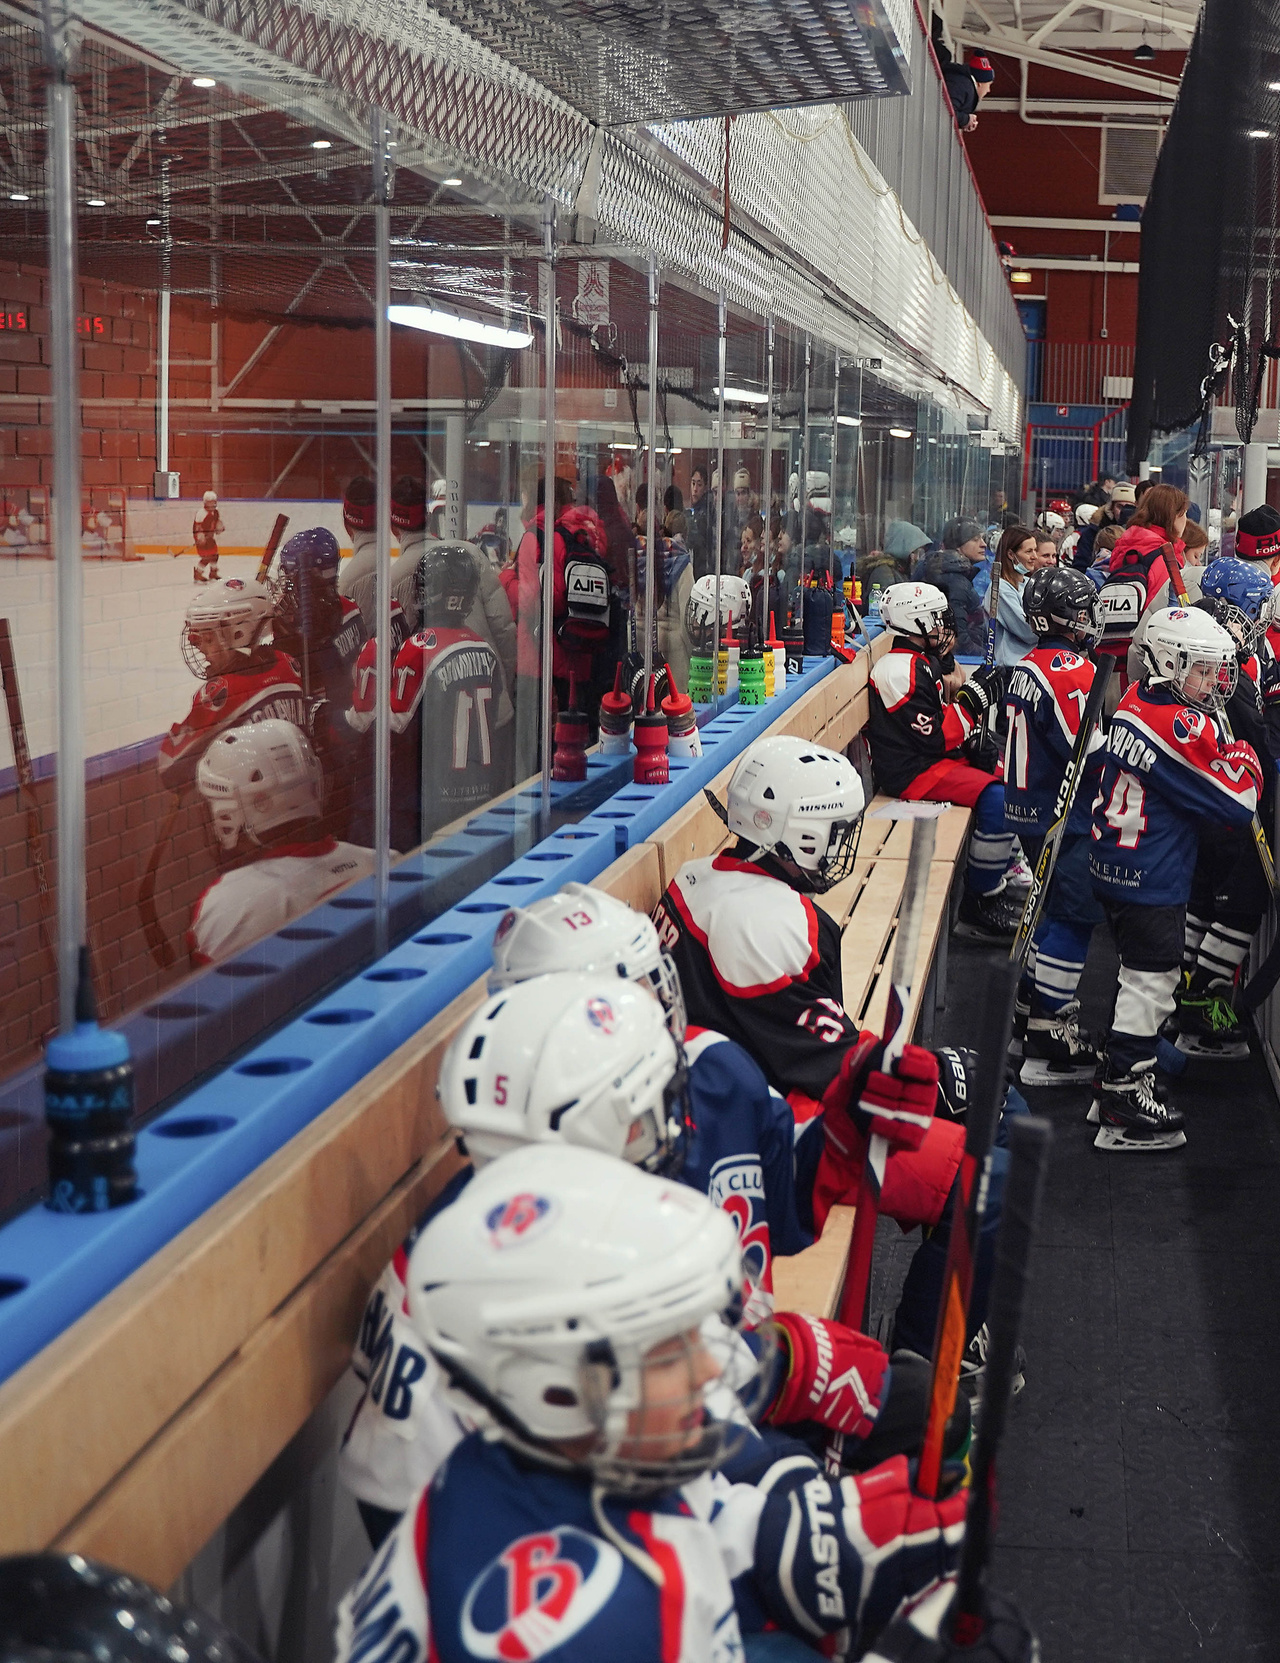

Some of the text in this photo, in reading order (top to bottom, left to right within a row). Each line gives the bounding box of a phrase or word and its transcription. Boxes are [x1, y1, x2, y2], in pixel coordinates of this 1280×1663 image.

[1102, 598, 1132, 612] FILA
[1031, 615, 1050, 633] 19
[986, 627, 996, 667] ALPHA
[1068, 688, 1089, 722] 7
[1003, 703, 1029, 791] 71
[1053, 760, 1077, 818] CCM
[797, 800, 846, 813] MISSION
[561, 911, 593, 931] 13
[493, 1074, 510, 1106] 5
[729, 1172, 763, 1193] CLU
[803, 1476, 846, 1620] EASTO
